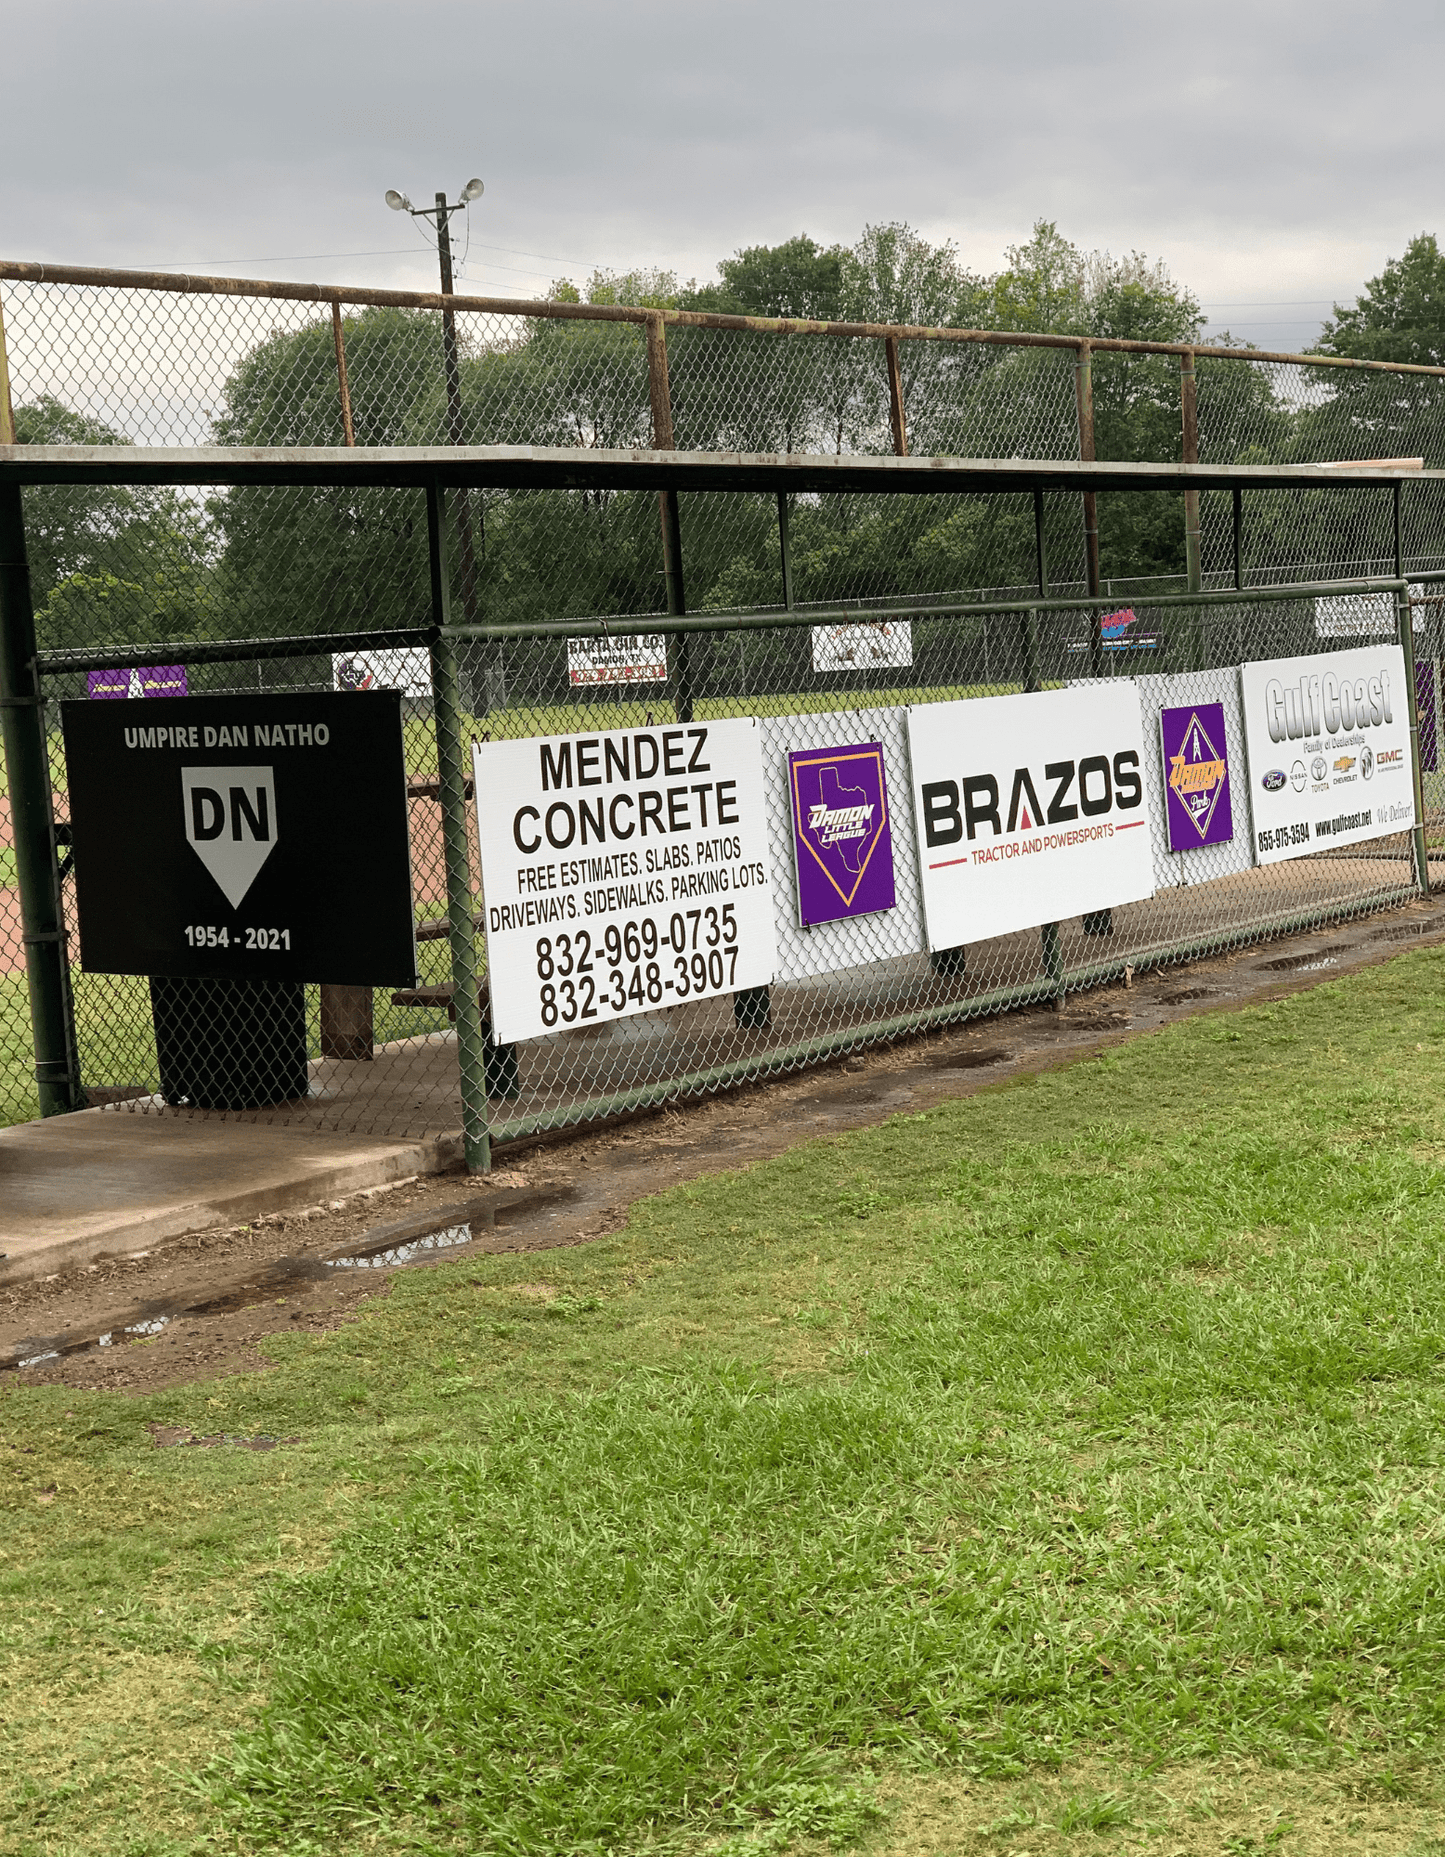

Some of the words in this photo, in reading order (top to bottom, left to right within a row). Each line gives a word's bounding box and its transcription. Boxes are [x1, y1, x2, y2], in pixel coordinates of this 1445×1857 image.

[124, 725, 199, 750] UMPIRE
[204, 724, 249, 748] DAN
[254, 722, 330, 748] NATHO
[1303, 740, 1323, 754] Family
[1324, 738, 1331, 749] of
[1331, 734, 1366, 749] Dealerships
[539, 727, 711, 792] MENDEZ
[1376, 748, 1403, 765] GMC
[1289, 772, 1308, 781] NISSAN
[1311, 782, 1330, 793] TOYOTA
[1333, 774, 1358, 785] CHEVROLET
[190, 786, 271, 843] DN
[808, 803, 876, 829] DAMON
[921, 749, 1143, 848] BRAZOS
[512, 779, 740, 855] CONCRETE
[824, 820, 864, 834] LITTLE
[1258, 821, 1310, 853] 855-975-3594
[1315, 808, 1372, 838] www.gulfcoast.net
[821, 828, 867, 843] LEAGUE
[970, 842, 1021, 866] TRACTOR
[1021, 839, 1043, 858] AND
[1043, 822, 1115, 853] POWERSPORTS
[517, 863, 557, 895] FREE
[560, 851, 643, 888] ESTIMATES.
[645, 843, 695, 874] SLABS.
[696, 835, 742, 866] PATIOS
[489, 894, 581, 934] DRIVEWAYS.
[583, 880, 669, 916] SIDEWALKS.
[671, 869, 730, 900] PARKING
[732, 861, 769, 890] LOTS.
[184, 925, 230, 948] 1954
[245, 927, 291, 951] 2021
[535, 902, 738, 982] 832-969-0735
[540, 945, 740, 1028] 832-348-3907
